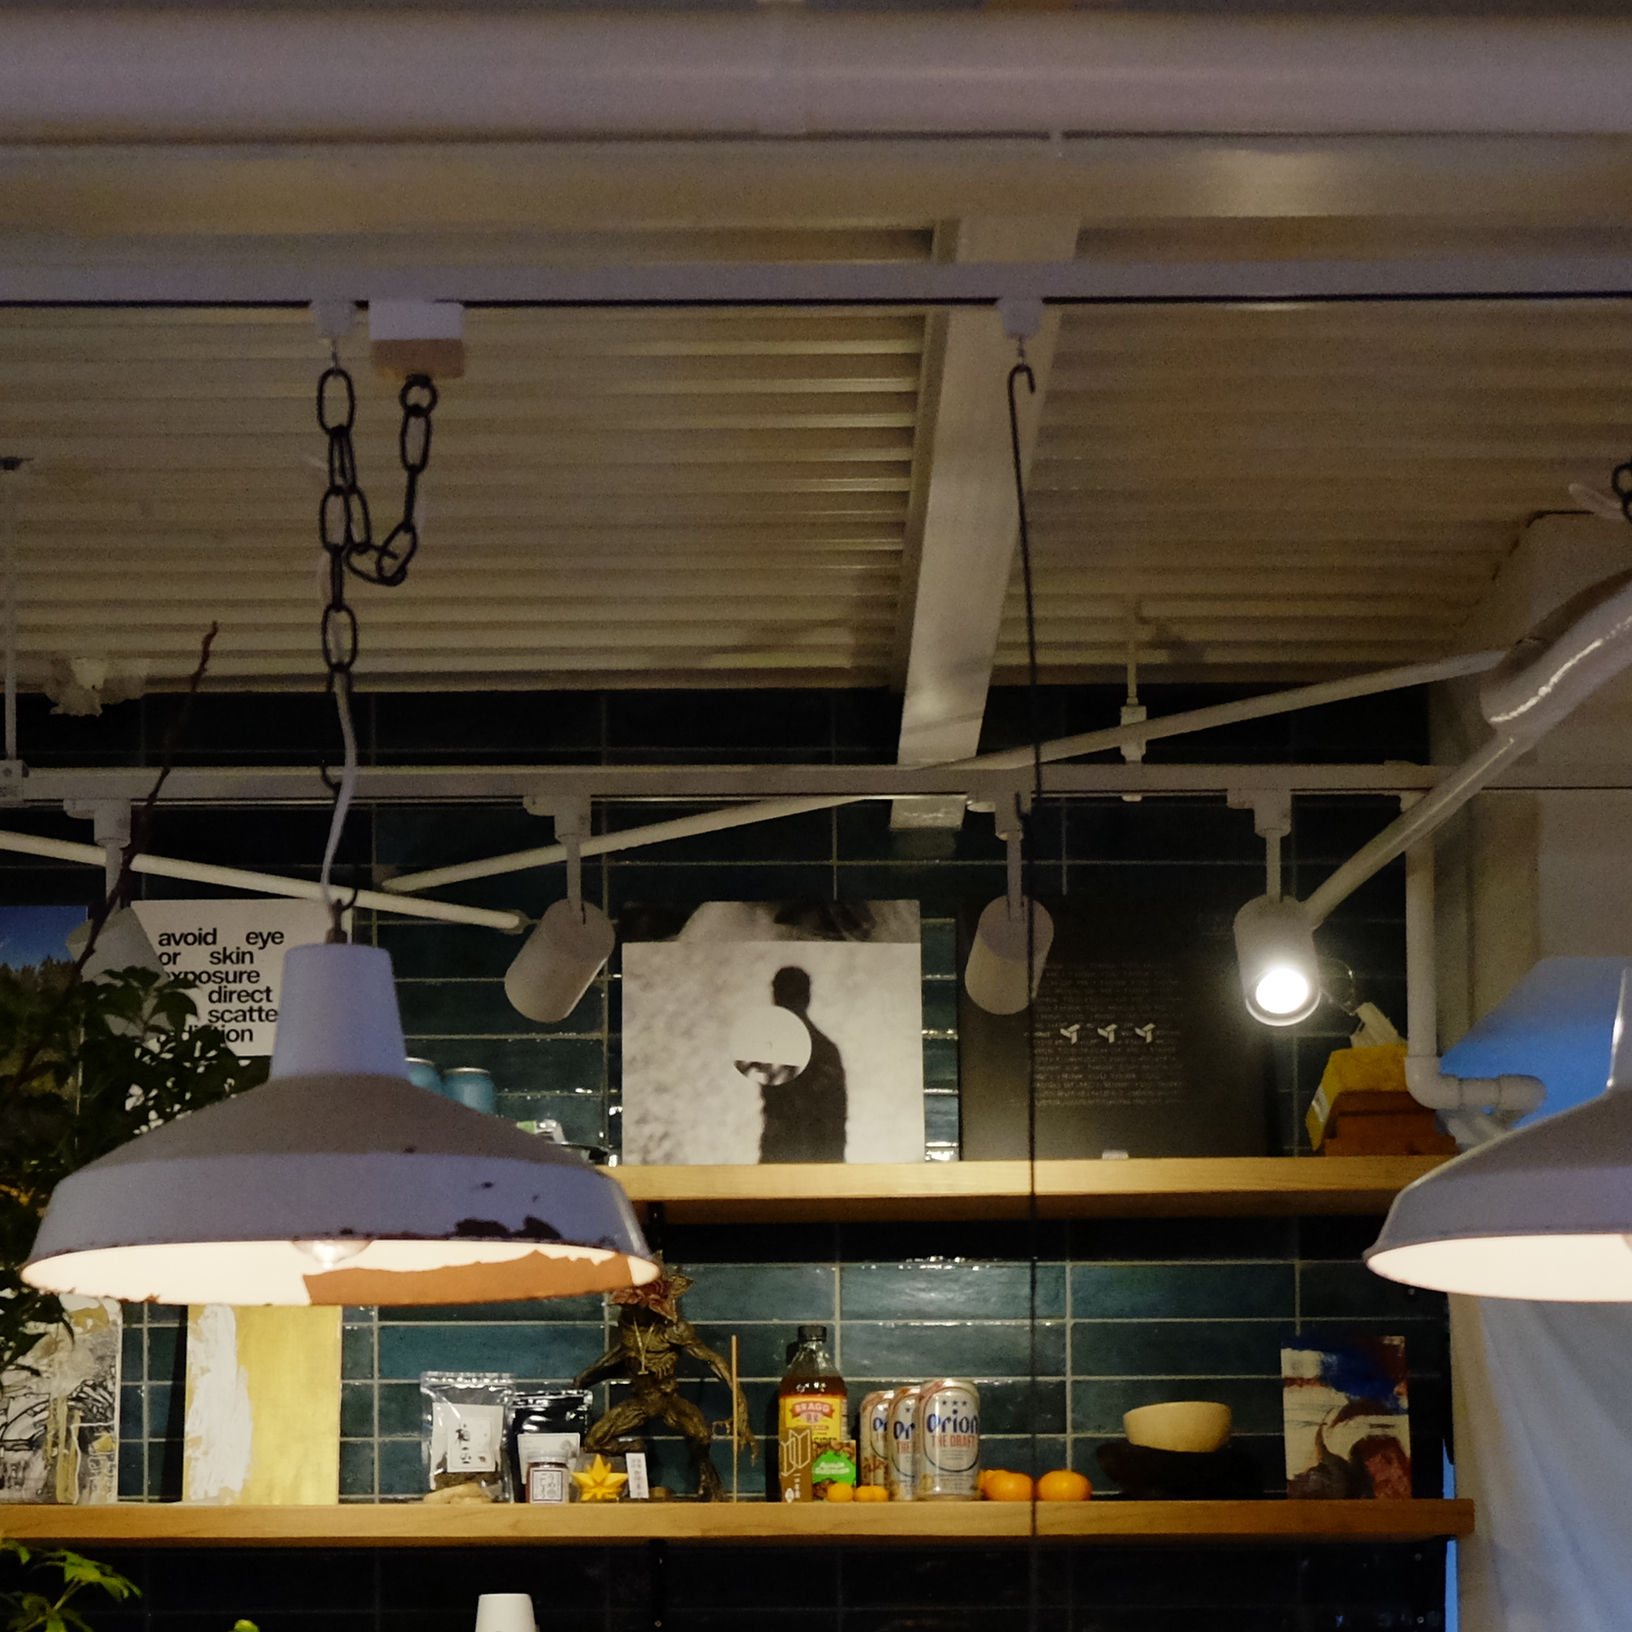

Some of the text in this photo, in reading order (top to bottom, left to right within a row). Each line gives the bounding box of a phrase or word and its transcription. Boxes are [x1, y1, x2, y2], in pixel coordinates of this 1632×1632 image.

[158, 928, 284, 950] avoid eye
[158, 947, 254, 966] or skin
[167, 969, 260, 985] xposure
[208, 986, 273, 1004] direct
[926, 1409, 979, 1435] Orion
